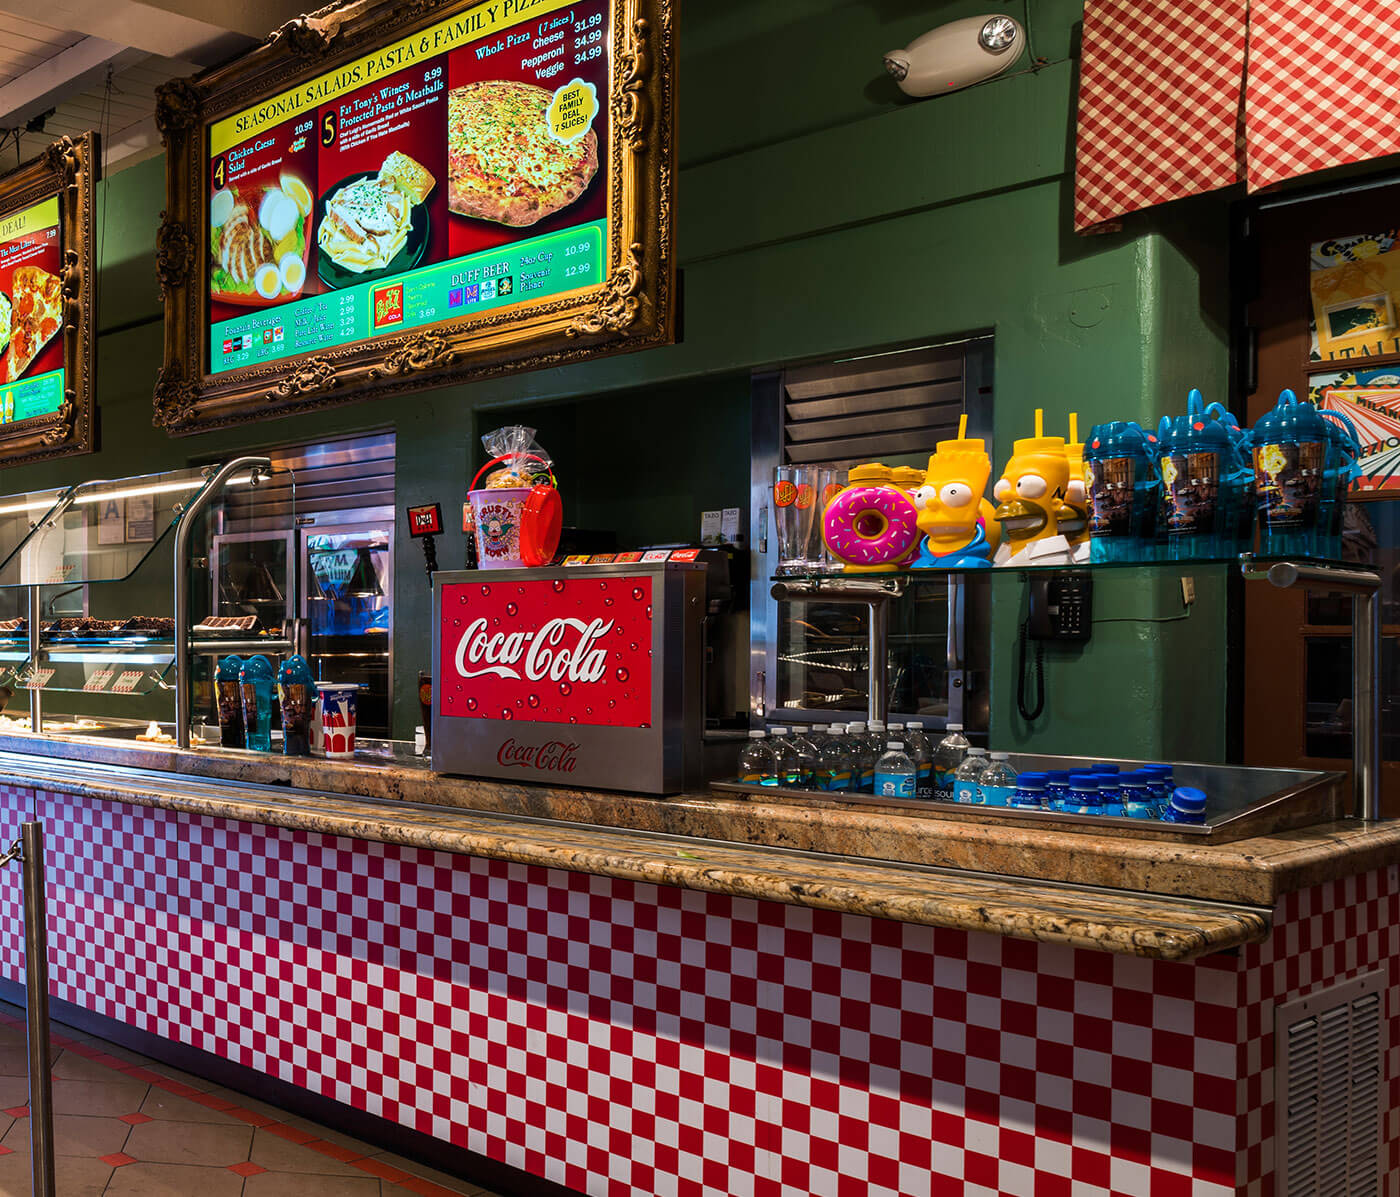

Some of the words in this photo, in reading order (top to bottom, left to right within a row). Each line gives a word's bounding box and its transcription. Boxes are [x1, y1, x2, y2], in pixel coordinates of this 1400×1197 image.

[532, 30, 564, 50] Cheese
[574, 13, 602, 33] 31.99
[475, 40, 504, 60] Whole
[506, 31, 531, 48] Pizza
[521, 44, 564, 70] Pepperoni
[574, 29, 602, 49] 34.99
[235, 94, 304, 134] SEASONAL
[366, 43, 415, 77] PASTA
[419, 37, 429, 53] &
[433, 6, 498, 48] FAMILY
[535, 62, 564, 80] Veggie
[574, 45, 602, 66] 34.99
[424, 66, 443, 82] 8.99
[340, 108, 374, 129] Protected
[375, 101, 395, 116] Pasta
[405, 79, 444, 103] Meatballs
[353, 93, 378, 109] Tony's
[380, 82, 410, 100] Witness
[558, 97, 583, 112] FAMILY
[562, 89, 580, 102] BEST
[555, 124, 560, 132] 7
[561, 114, 588, 131] SLICES!
[562, 108, 580, 121] DEAL
[294, 120, 313, 136] 10.99
[323, 115, 334, 144] 5
[228, 146, 254, 162] Chicken
[214, 160, 224, 186] 4
[228, 159, 245, 174] Salad
[564, 242, 590, 257] 10.99
[451, 268, 480, 286] DUFF
[483, 261, 510, 279] BEER
[564, 263, 591, 277] 12.99
[340, 294, 355, 305] 2.99
[340, 305, 355, 316] 2.99
[252, 315, 282, 329] Beverages
[1356, 395, 1400, 421] MILAN
[104, 498, 121, 519] A
[455, 617, 615, 683] Coca-Cola
[497, 737, 581, 774] Coca-Cola
